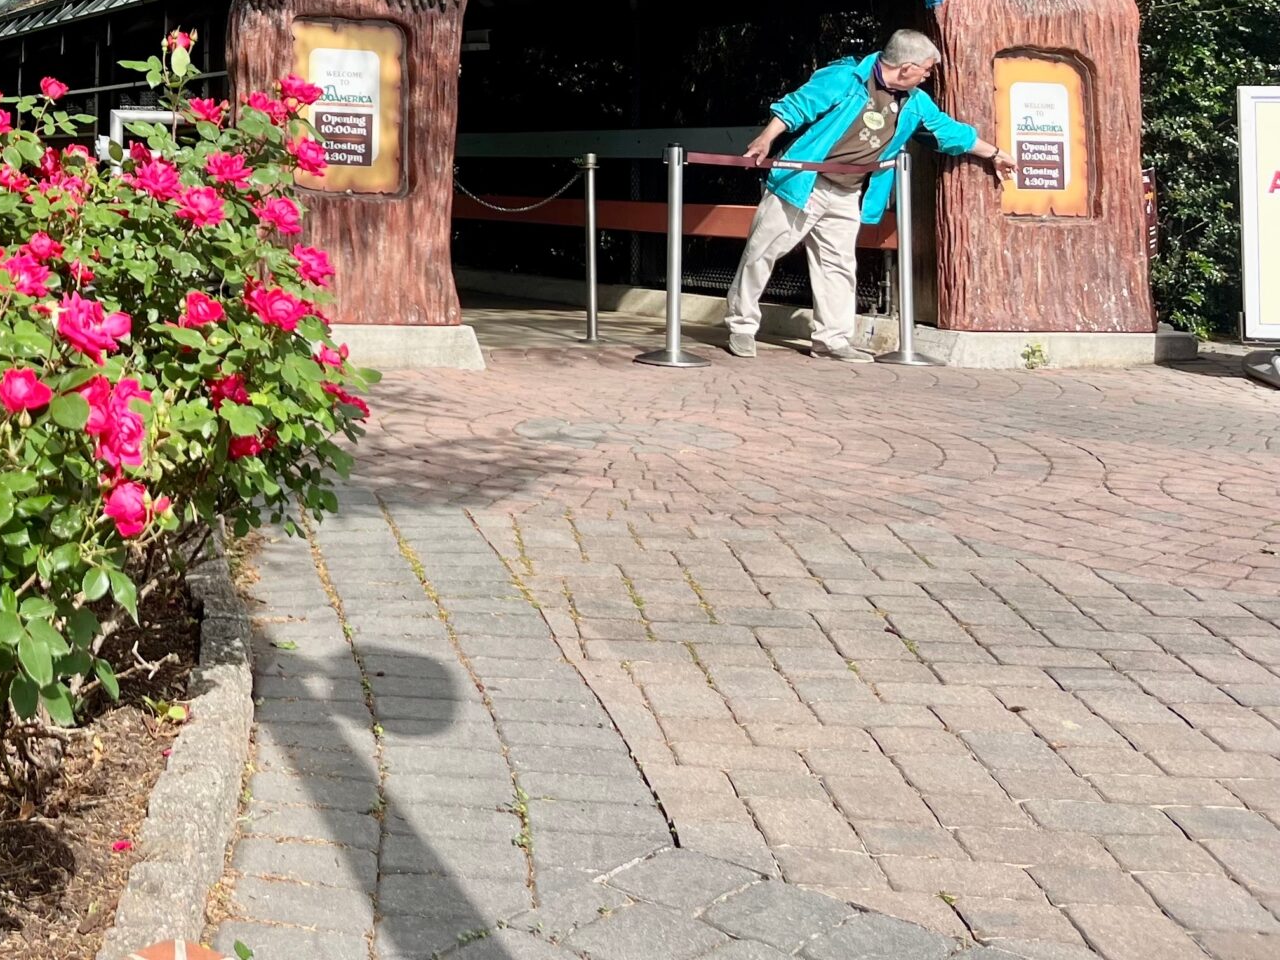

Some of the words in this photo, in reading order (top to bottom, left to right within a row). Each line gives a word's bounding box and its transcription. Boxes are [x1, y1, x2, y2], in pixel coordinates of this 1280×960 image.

[326, 70, 363, 79] WELCOME
[319, 85, 373, 103] OOAMERICA
[322, 114, 366, 127] Opening
[321, 125, 367, 136] 10:00am
[322, 140, 366, 153] Closing
[1022, 142, 1059, 154] Opening
[324, 152, 363, 164] 4:30pm
[1021, 152, 1060, 162] 10:00am
[1022, 166, 1060, 178] Closing
[1024, 177, 1058, 188] 4:30pm
